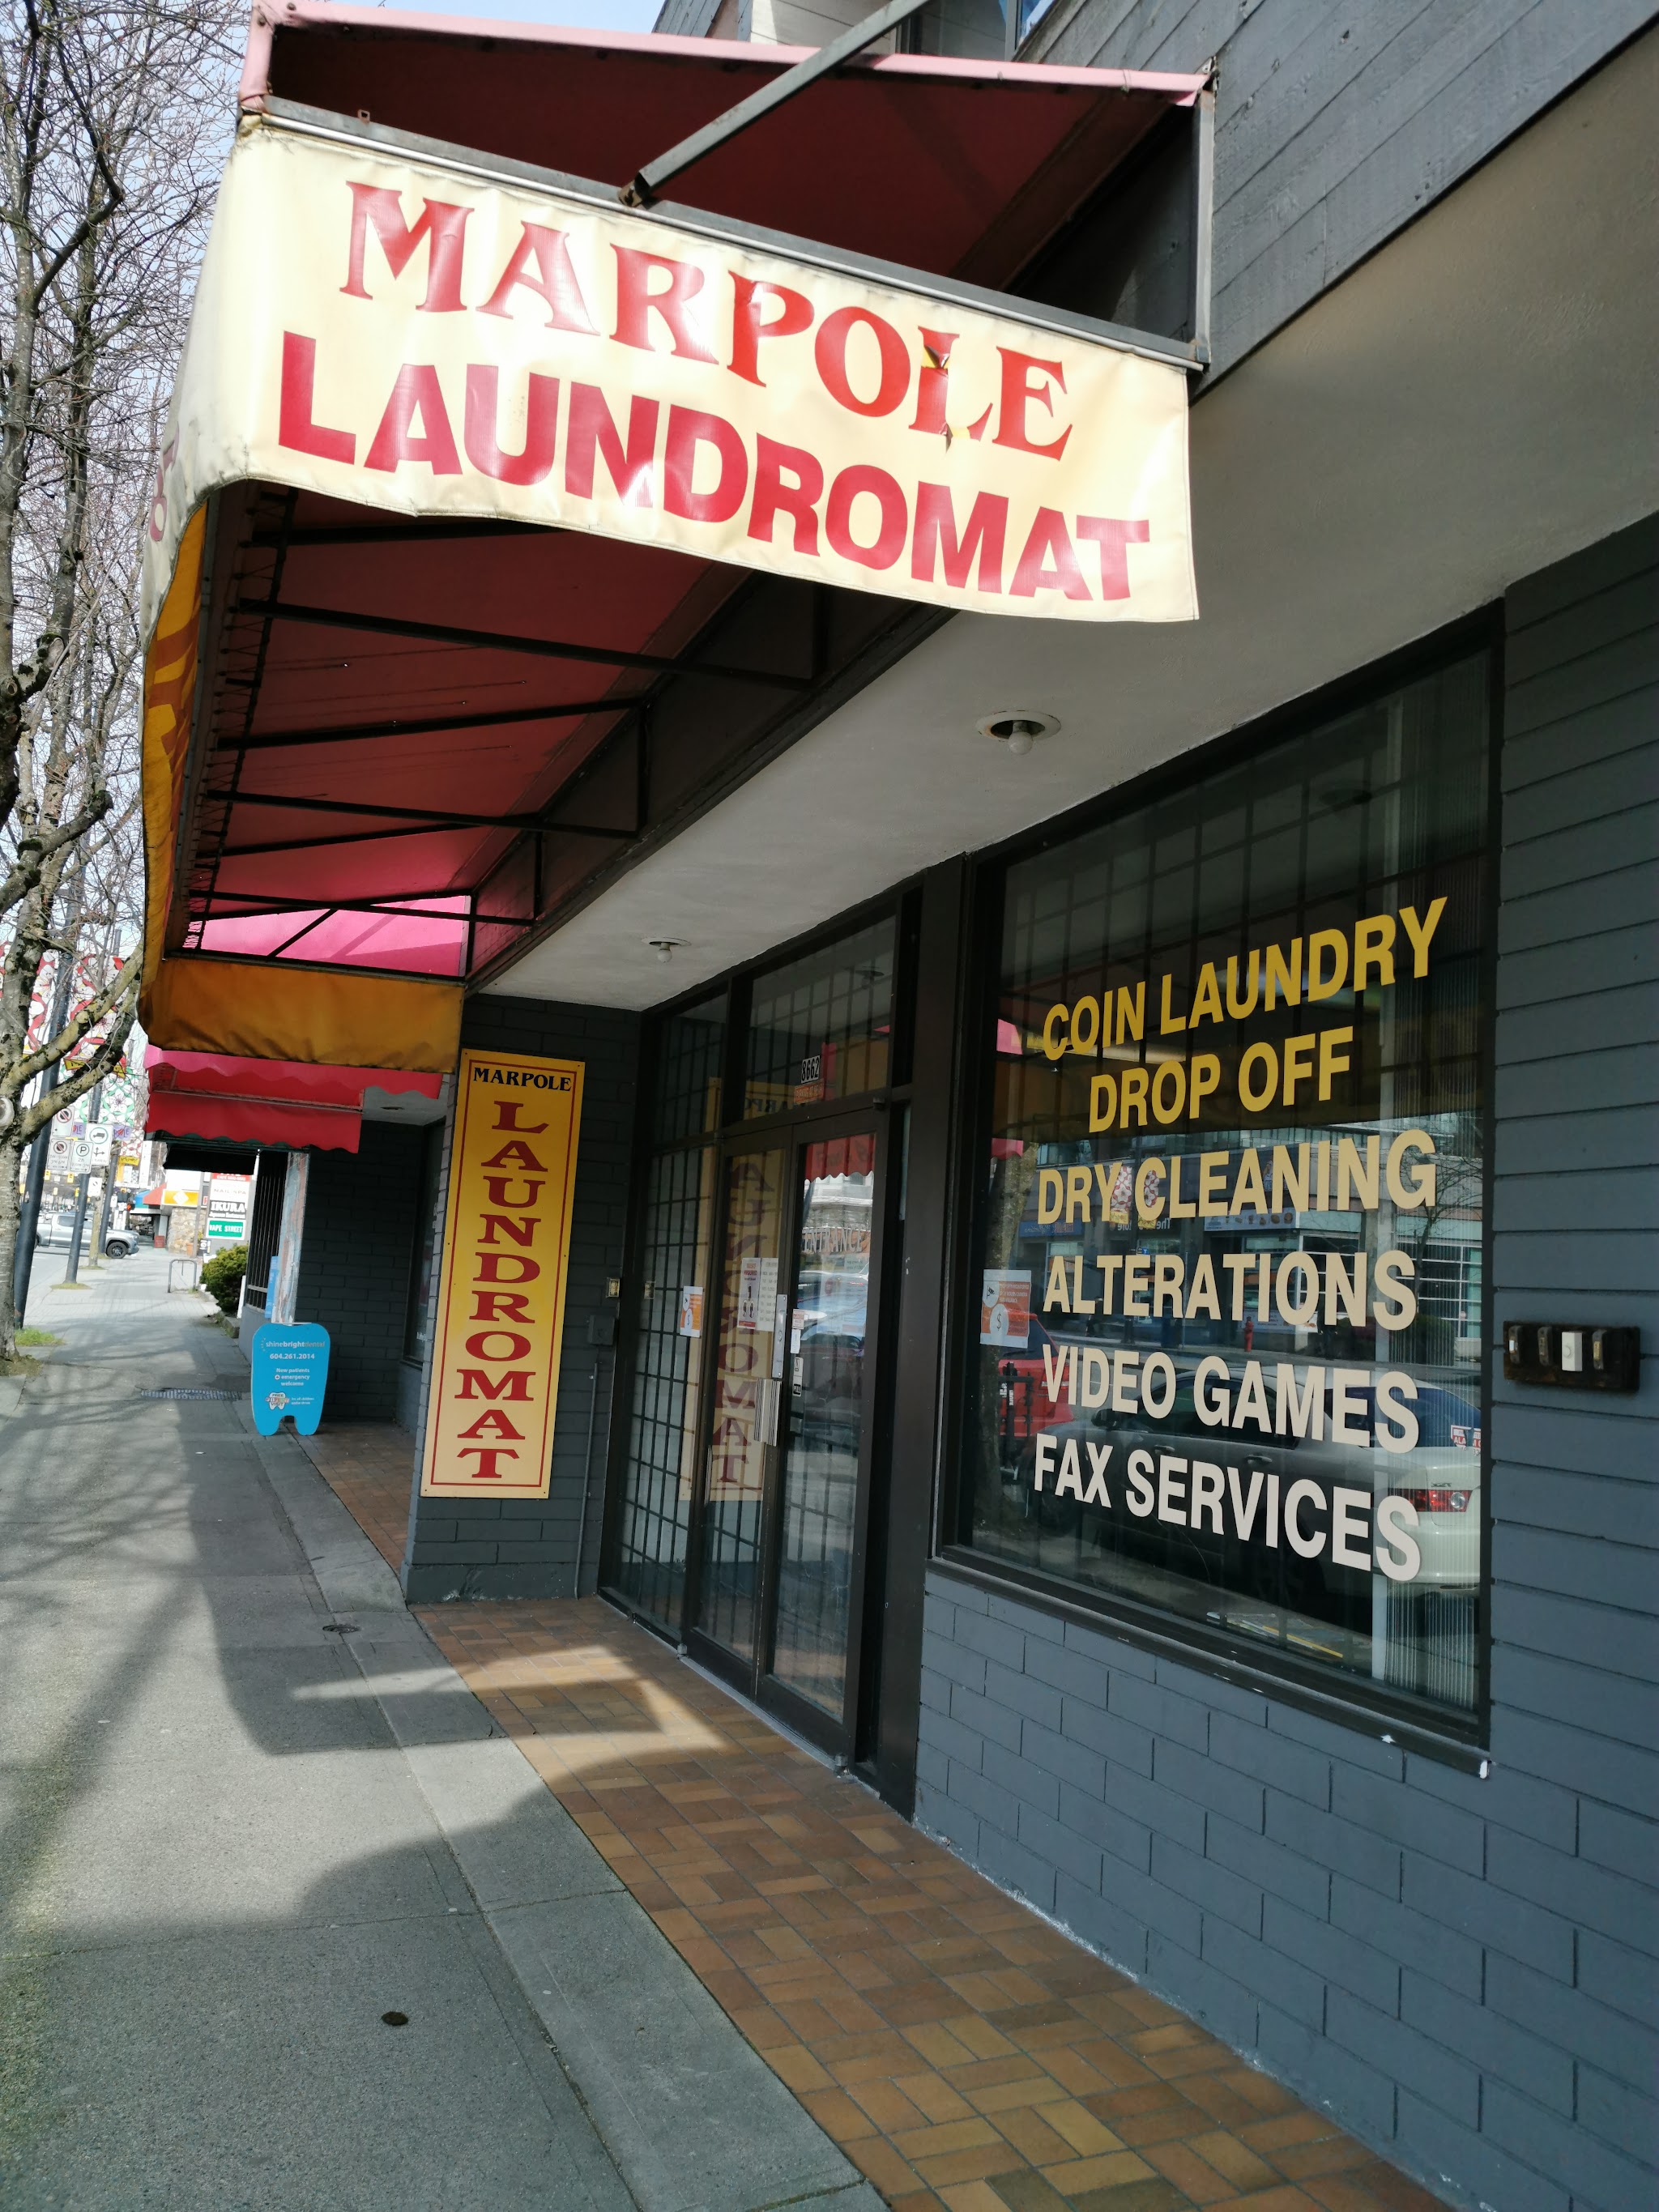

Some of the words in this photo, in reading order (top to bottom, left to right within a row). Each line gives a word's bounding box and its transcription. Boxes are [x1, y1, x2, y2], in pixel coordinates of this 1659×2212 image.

[339, 181, 1073, 462] MARPOLE
[279, 331, 1149, 602] LAUNDROMAT
[1043, 981, 1145, 1061] COIN
[1160, 897, 1448, 1035] LAUNDRY
[472, 1067, 573, 1093] MARPOLE
[802, 1057, 820, 1080] 8662
[1089, 1053, 1221, 1132] DROP
[1238, 1026, 1354, 1112] OFF
[211, 1201, 245, 1213] IKURA
[1038, 1161, 1124, 1224] DRY
[1134, 1128, 1436, 1221] CLEANING
[224, 1225, 242, 1234] STREET
[802, 1227, 862, 1254] ENTRANCE
[454, 1100, 550, 1479] LAUNDROMAT
[1043, 1250, 1417, 1331] ALTERATIONS
[266, 1340, 325, 1349] shinebrightdental
[1043, 1343, 1176, 1420] VIDEO
[1193, 1354, 1419, 1454] GAMES
[1034, 1433, 1112, 1509] FAX
[1125, 1449, 1421, 1582] SERVICES
